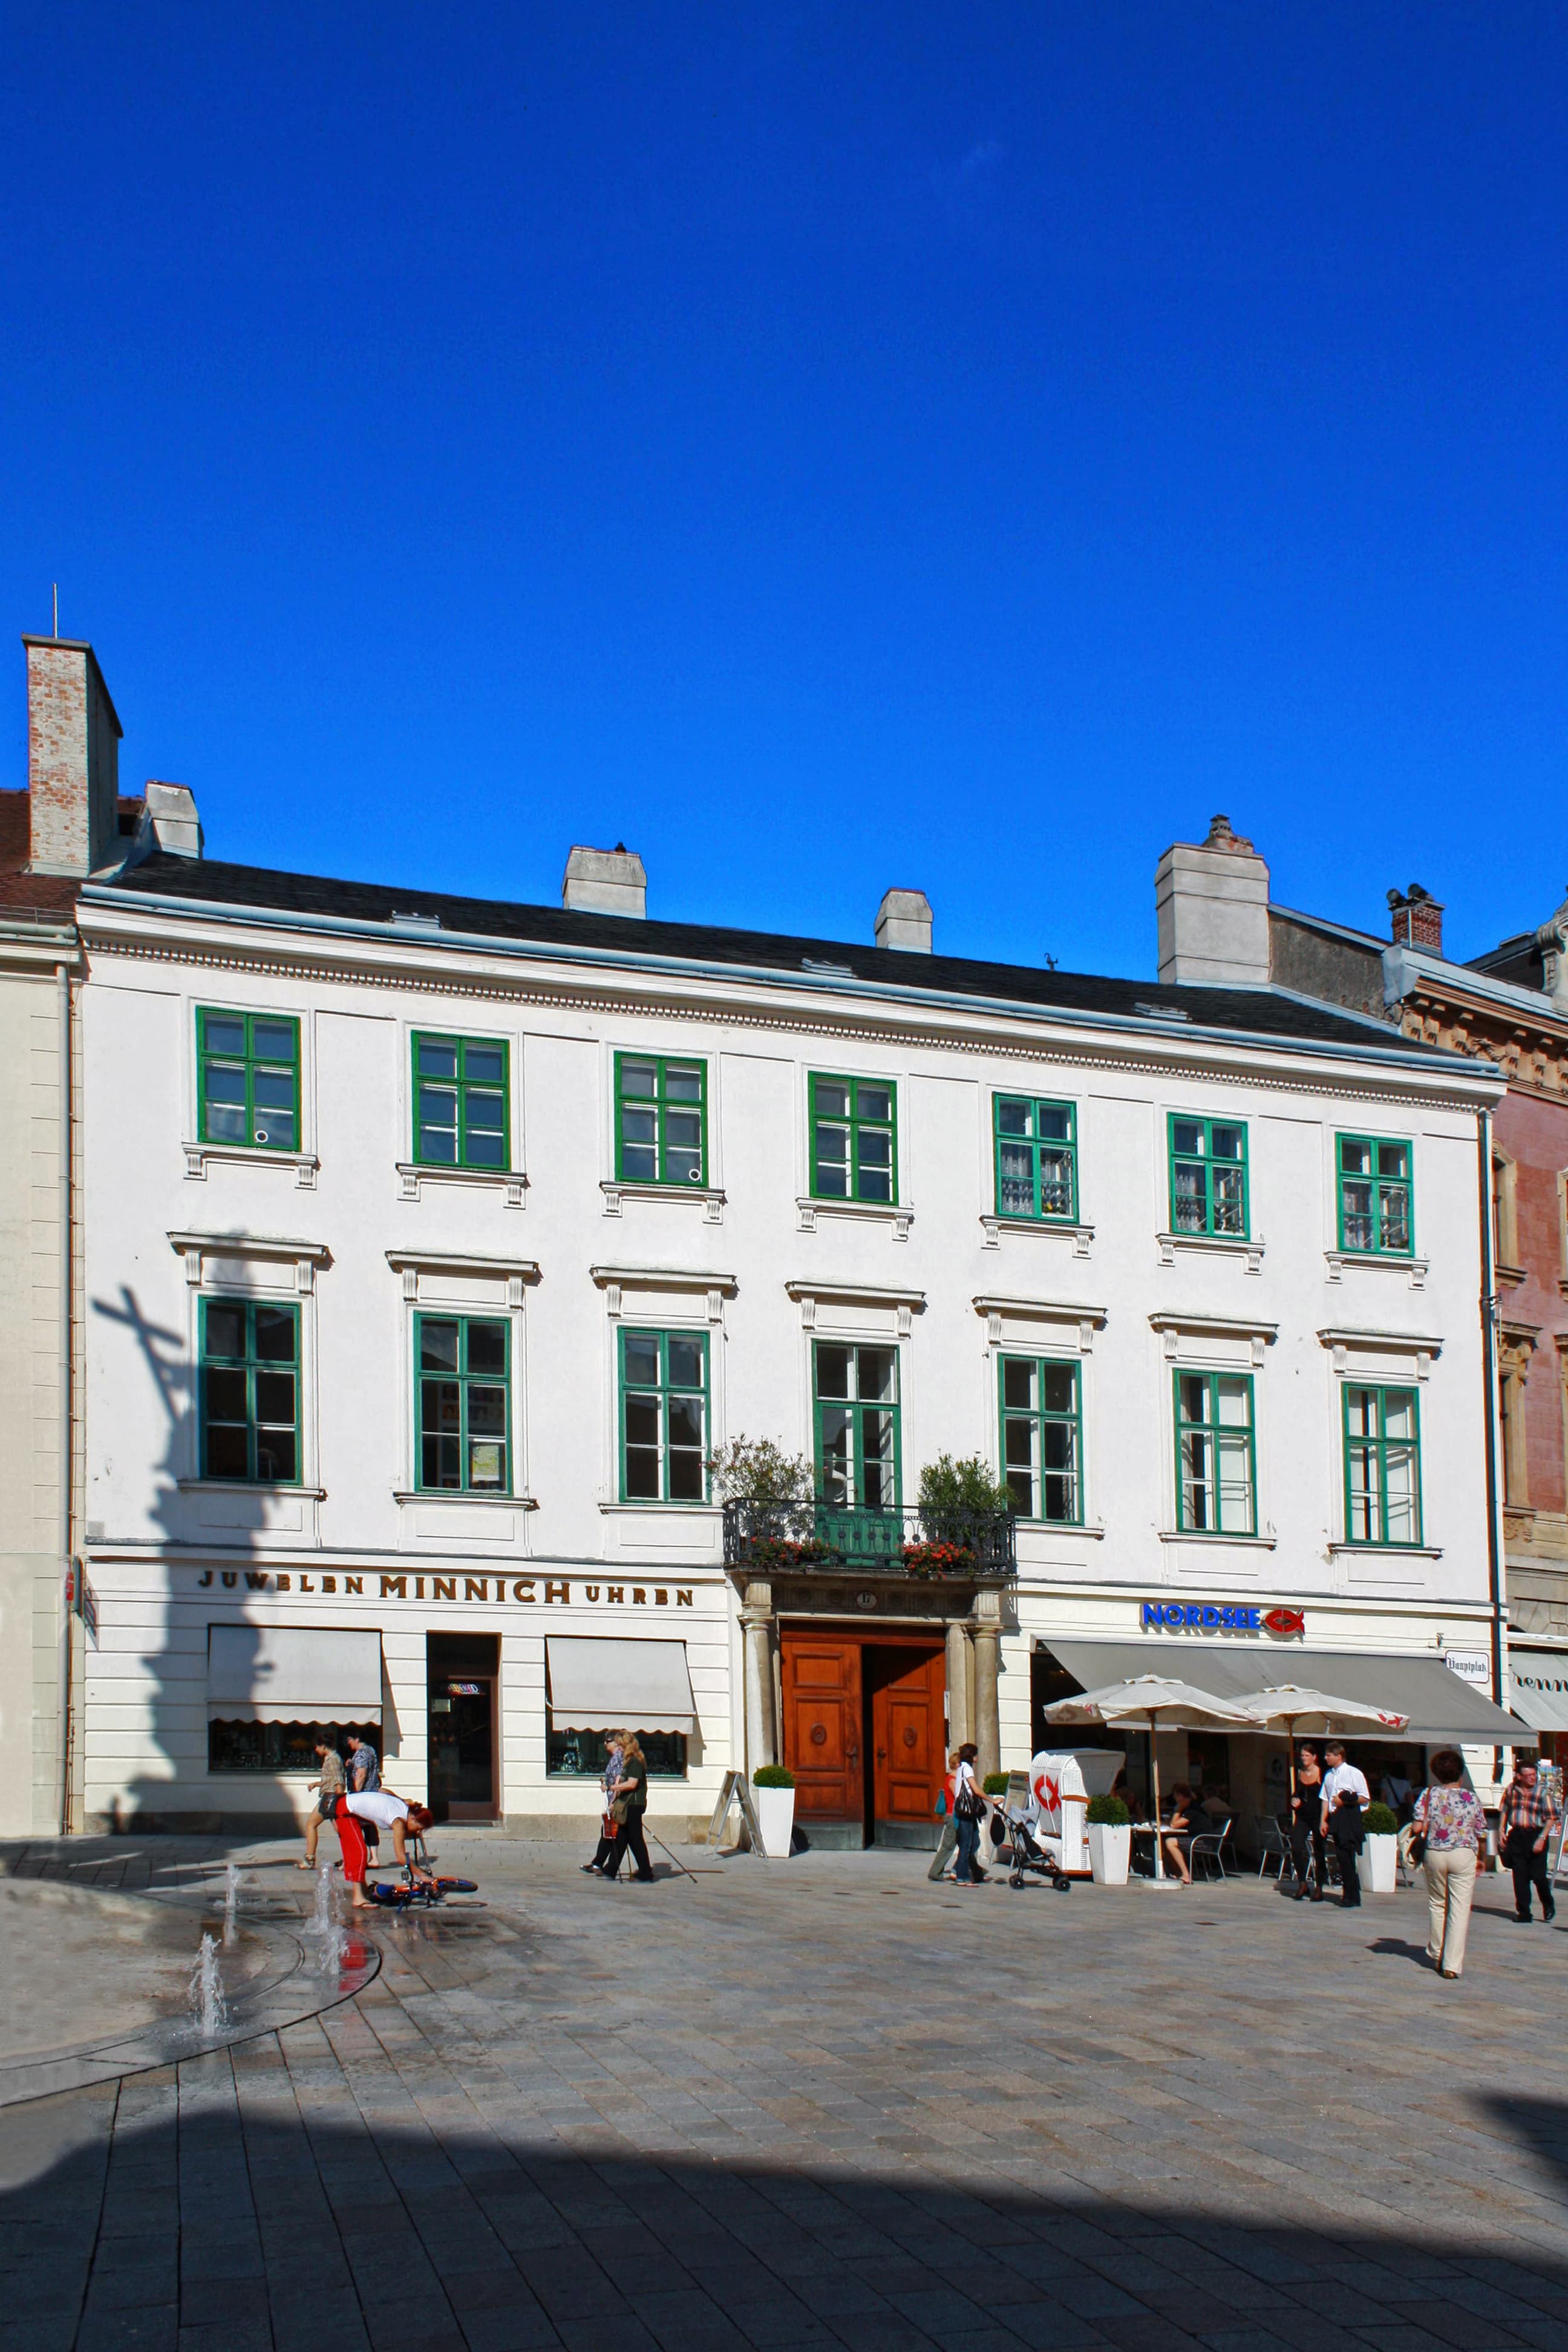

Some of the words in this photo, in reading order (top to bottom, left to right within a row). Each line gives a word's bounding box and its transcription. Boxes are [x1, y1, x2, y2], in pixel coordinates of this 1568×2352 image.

[198, 1571, 364, 1593] JUWELEN
[379, 1575, 570, 1604] MINNICH
[585, 1586, 693, 1606] UHREN
[862, 1592, 871, 1603] 17
[1142, 1603, 1261, 1630] NORDSEE
